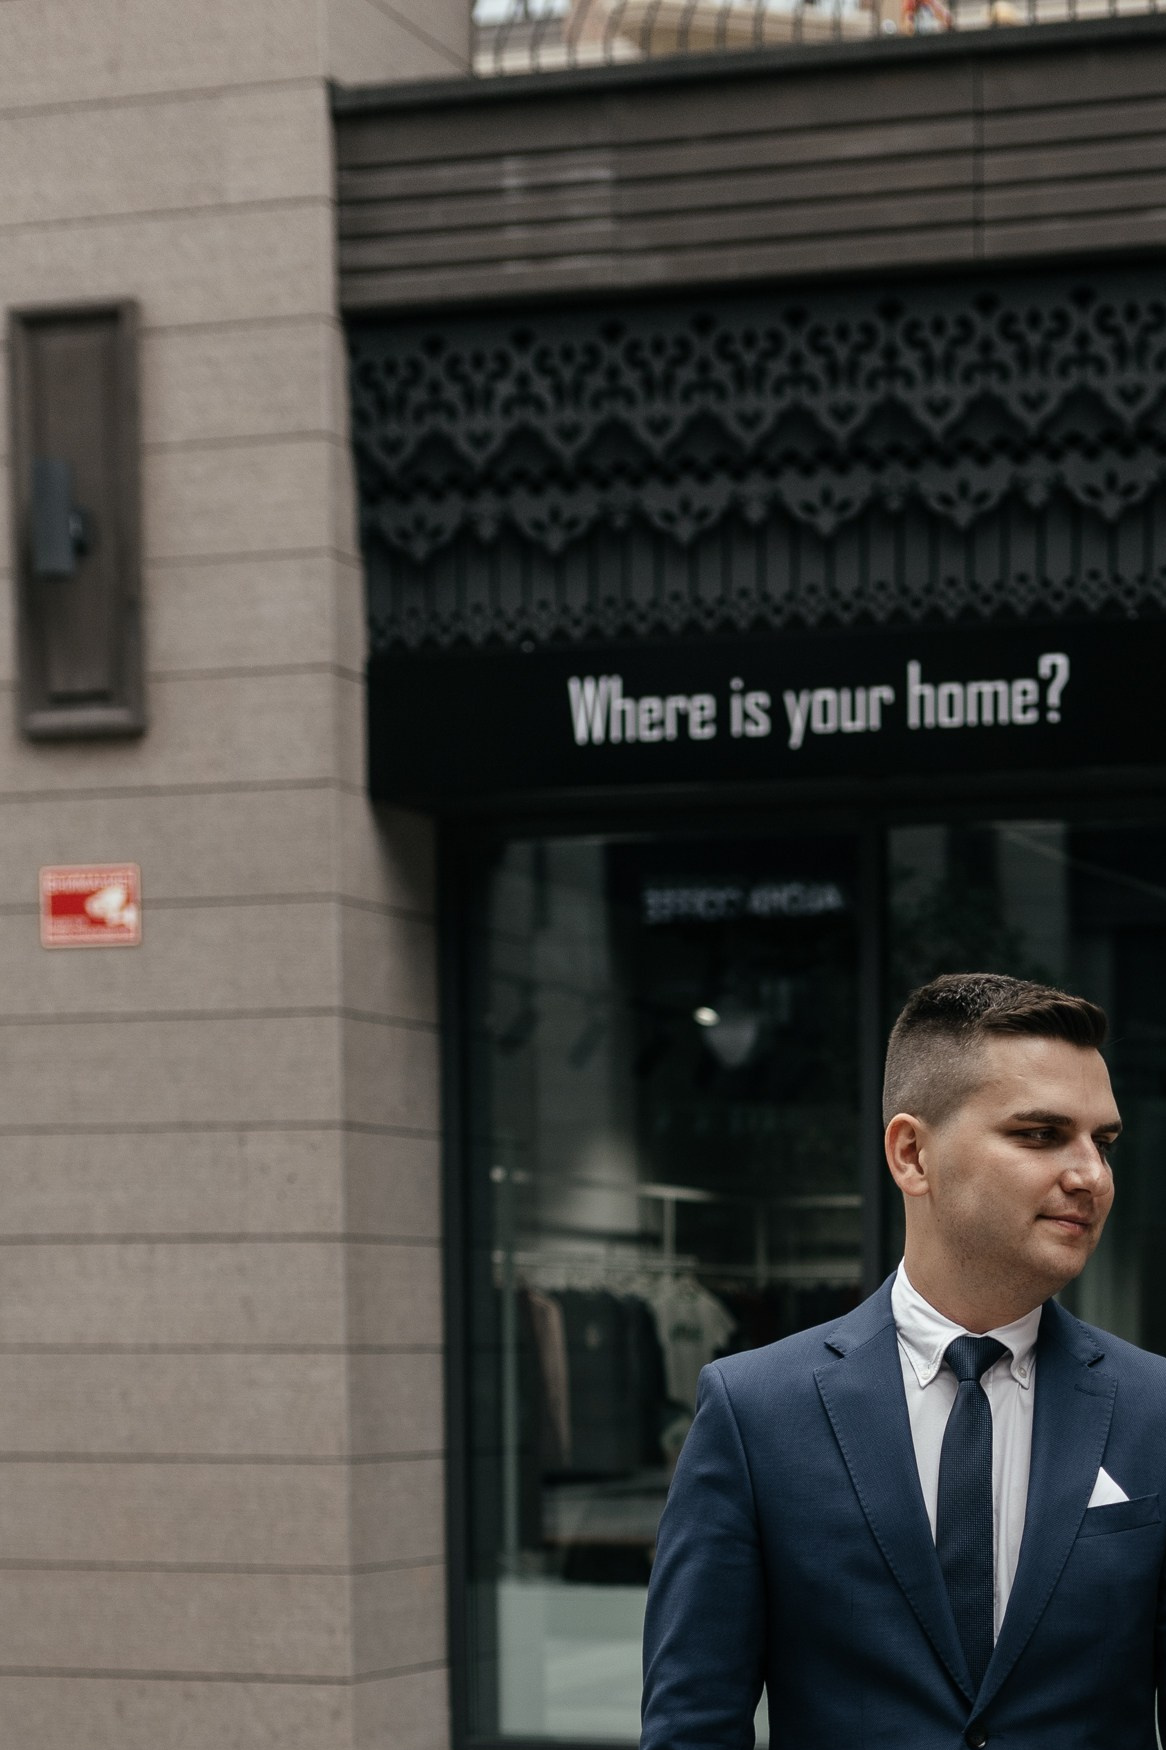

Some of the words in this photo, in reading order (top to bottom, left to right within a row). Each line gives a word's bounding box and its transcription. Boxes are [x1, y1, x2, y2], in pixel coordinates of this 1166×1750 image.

[568, 674, 717, 746] Where
[730, 676, 771, 738] is
[783, 685, 895, 750] your
[907, 652, 1070, 730] home?
